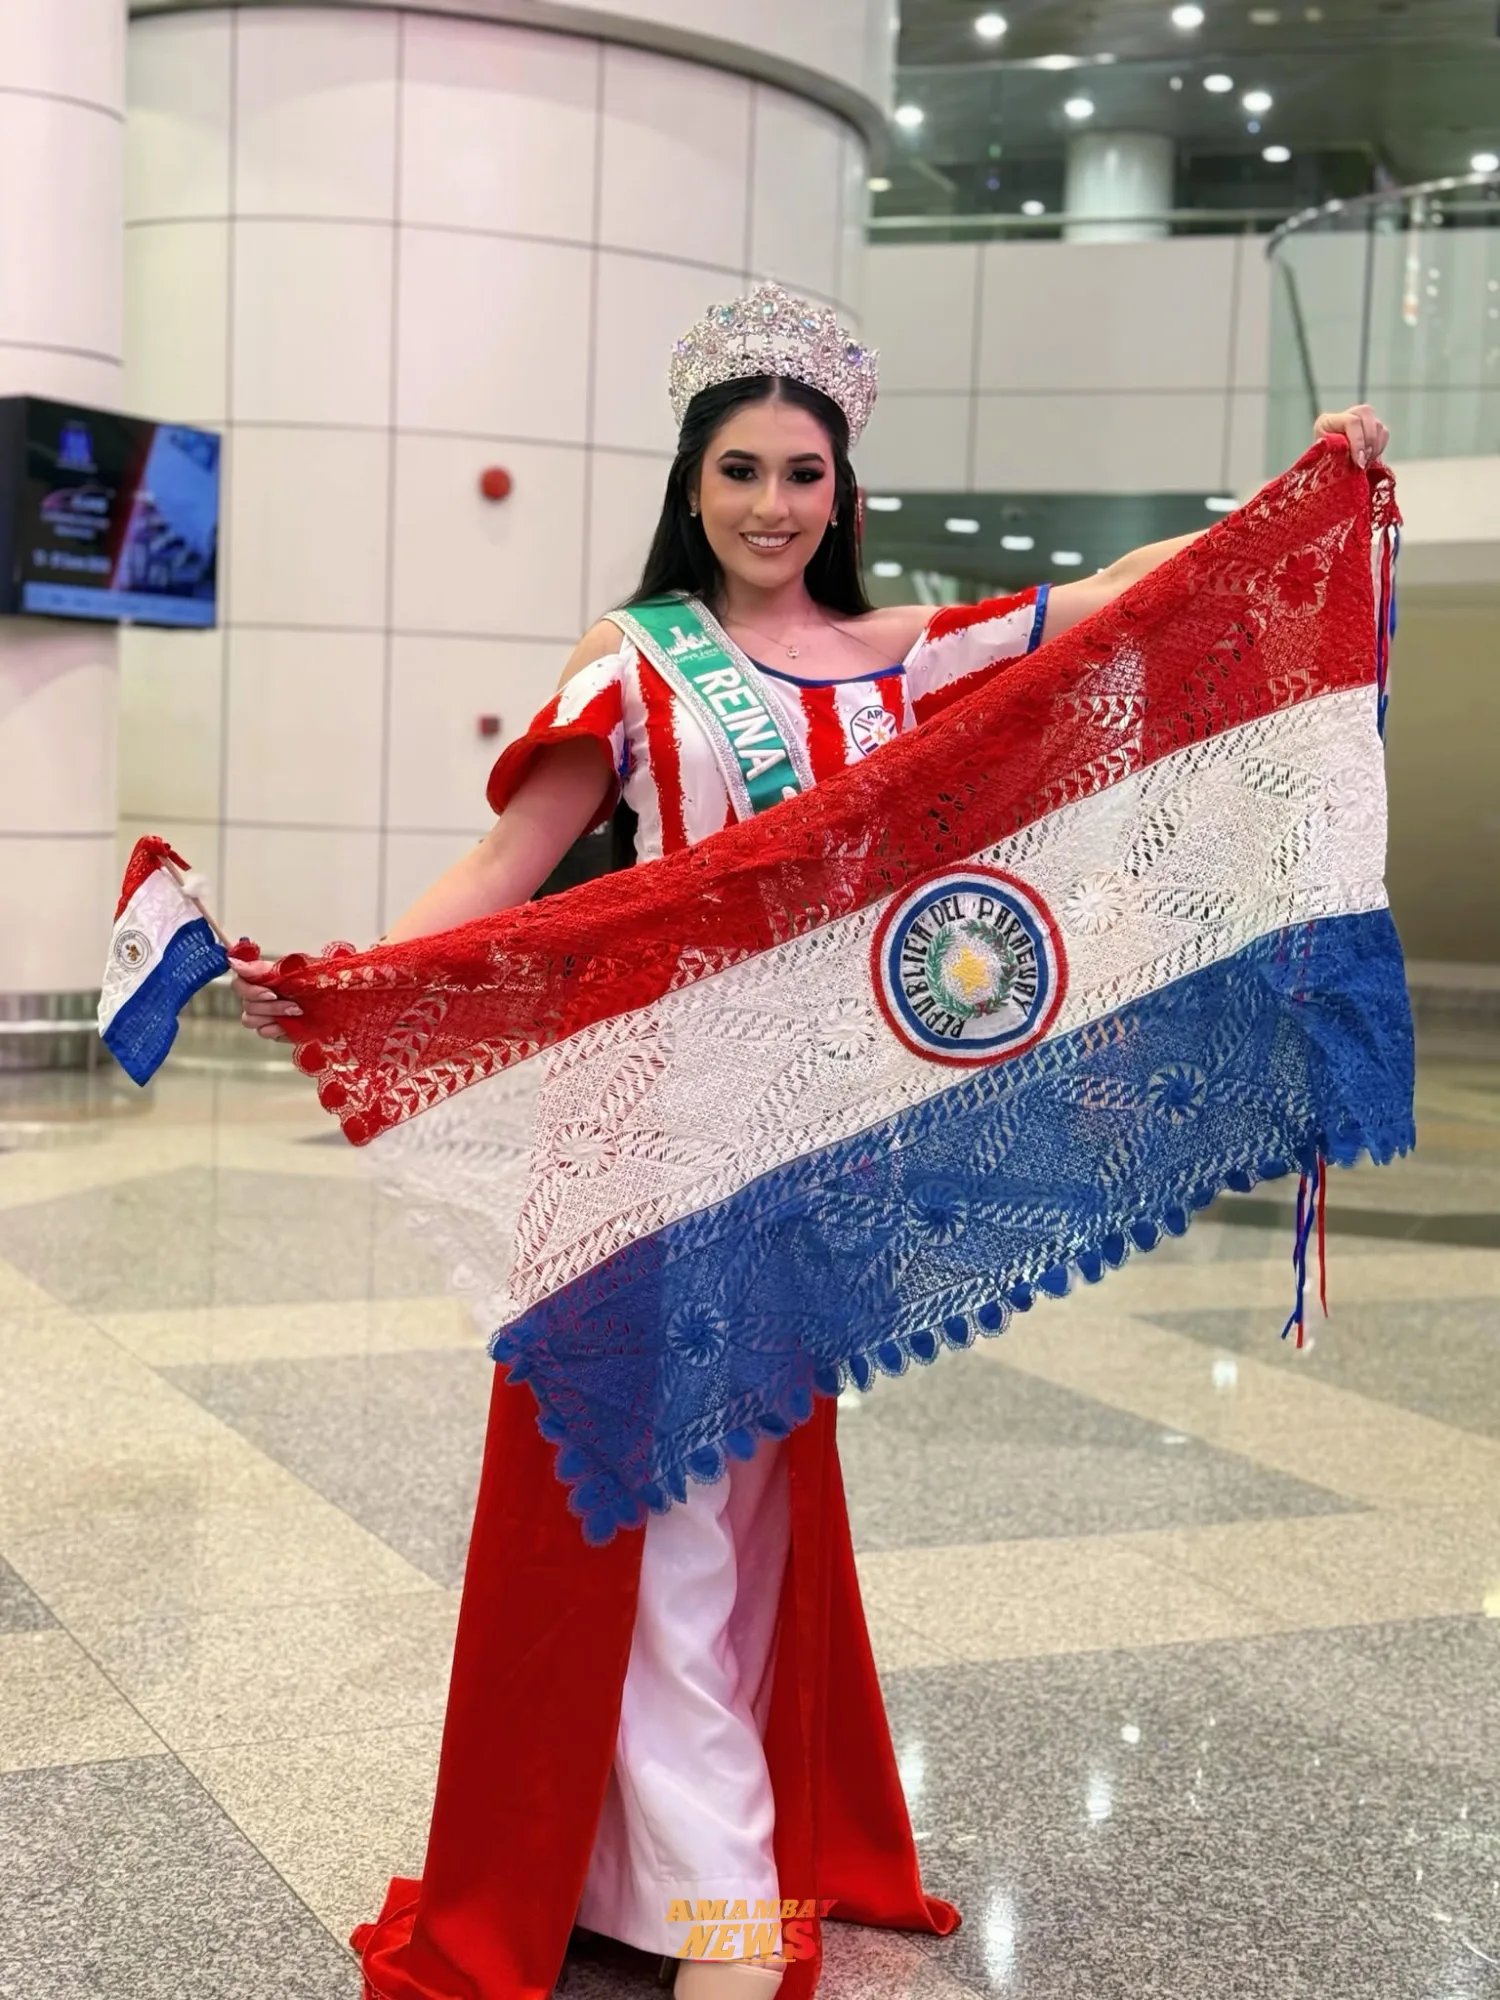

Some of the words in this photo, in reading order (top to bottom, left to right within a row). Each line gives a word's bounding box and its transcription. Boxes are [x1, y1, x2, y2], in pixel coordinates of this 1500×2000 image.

[693, 668, 786, 780] REINA
[929, 895, 965, 928] DEL
[978, 897, 1037, 1016] PARAGUAY
